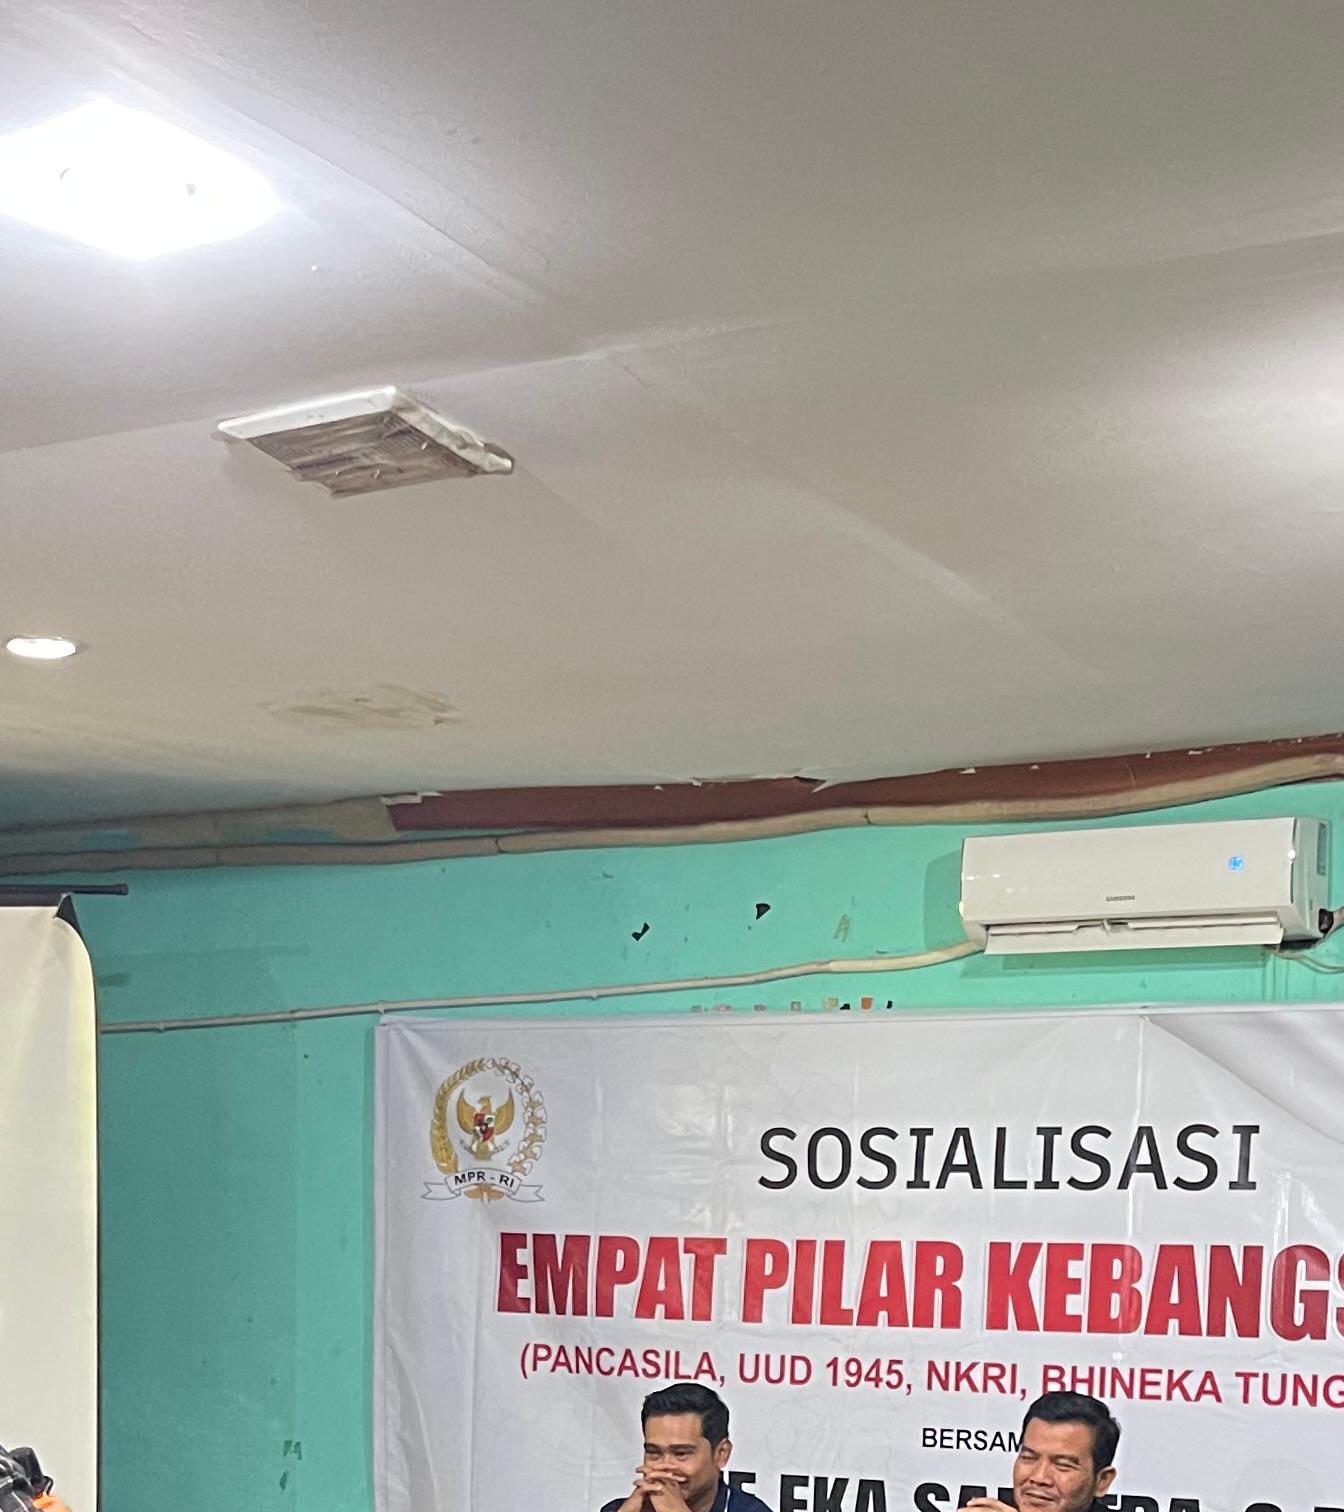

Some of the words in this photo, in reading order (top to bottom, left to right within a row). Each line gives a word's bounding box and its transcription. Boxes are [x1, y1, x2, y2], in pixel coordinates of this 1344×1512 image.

[454, 1171, 486, 1186] MPR
[499, 1174, 515, 1188] RI
[758, 1124, 1260, 1190] SOSIALISASI
[496, 1232, 728, 1322] EMPAT
[741, 1238, 965, 1330] PILAR
[520, 1343, 726, 1388] (PANCASILA,
[738, 1353, 813, 1386] UUD
[825, 1356, 912, 1395] 1945,
[926, 1360, 1027, 1401] NKRI,
[1041, 1364, 1224, 1404] BHINEKA
